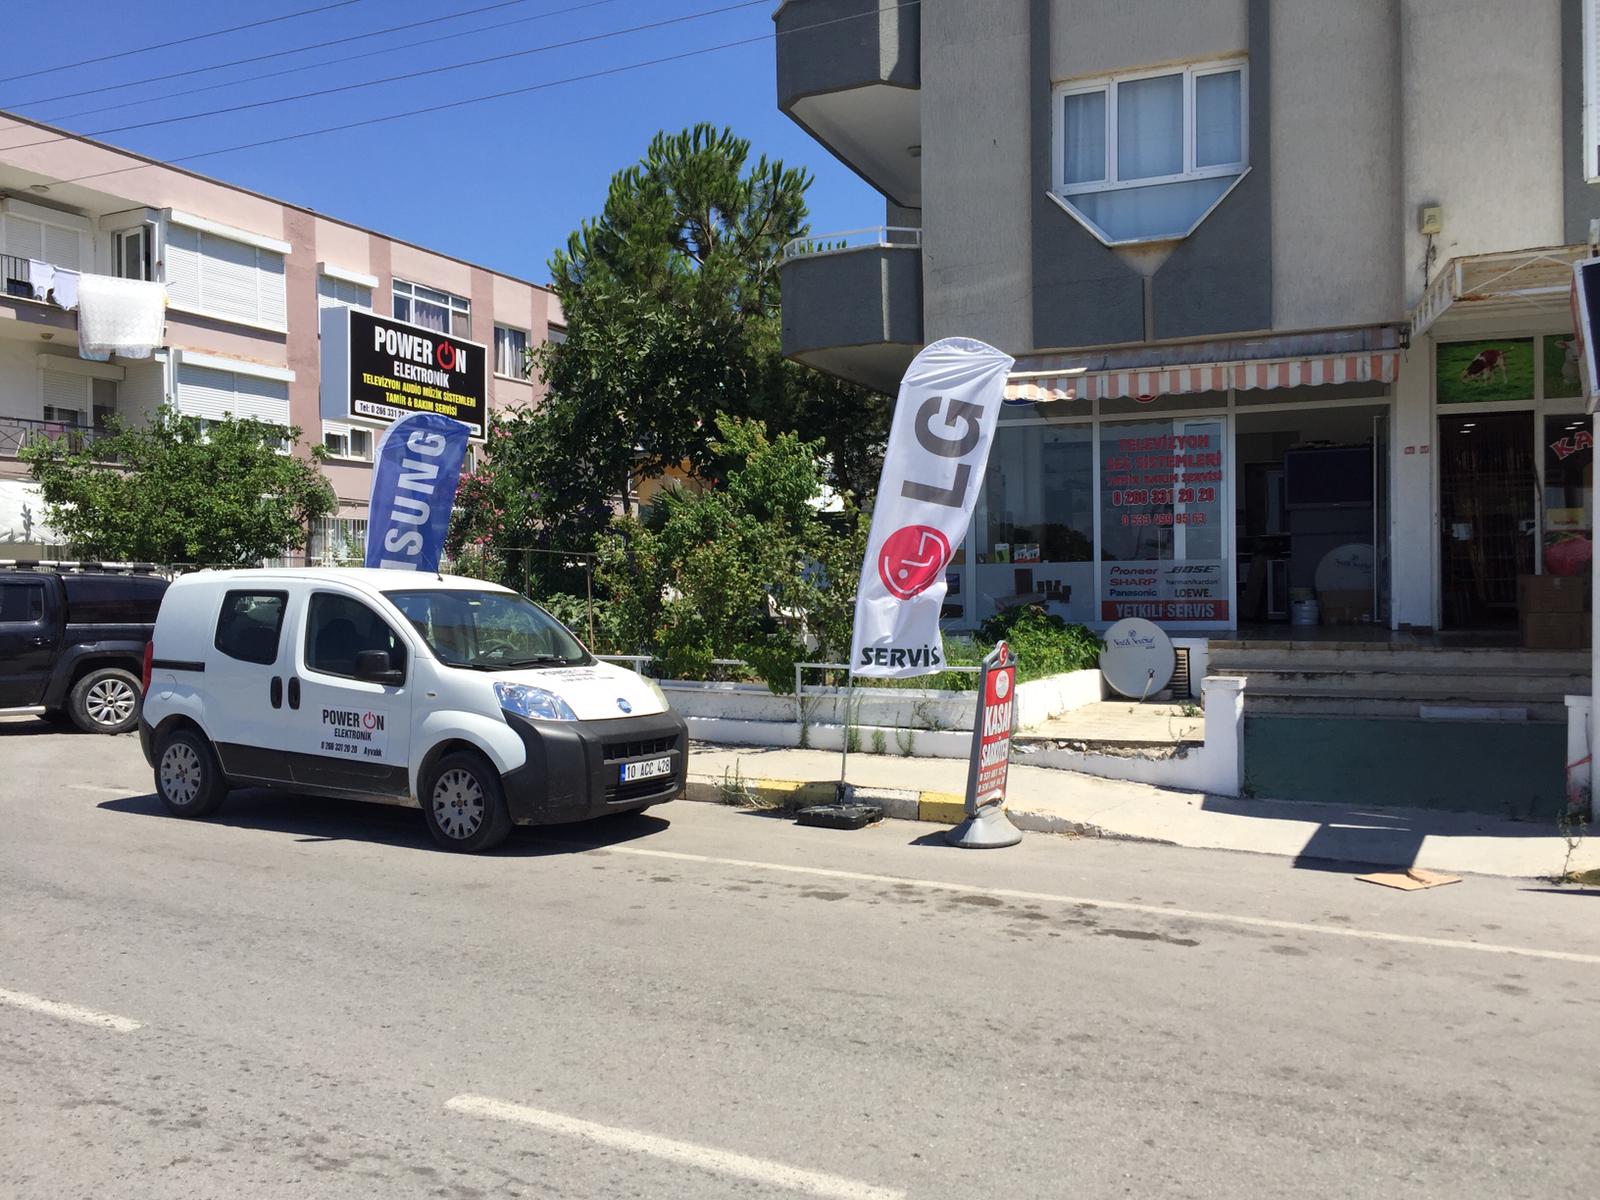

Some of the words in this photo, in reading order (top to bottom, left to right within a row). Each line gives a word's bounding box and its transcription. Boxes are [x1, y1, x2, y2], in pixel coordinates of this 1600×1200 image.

[374, 326, 432, 366] POWER
[362, 372, 400, 390] TELEVİZYON
[394, 361, 450, 388] ELEKTRONİK
[407, 397, 412, 407] &
[414, 399, 434, 412] BAKIM
[900, 396, 984, 508] LG
[380, 430, 446, 571] SUNG
[1112, 490, 1122, 506] 0
[1110, 578, 1158, 586] SHARP
[1110, 588, 1158, 597] Panasonic
[861, 644, 941, 668] SERVİS
[322, 709, 360, 728] POWER
[334, 728, 372, 741] ELEKTRONİK
[627, 765, 636, 778] 10
[640, 762, 654, 776] ACC
